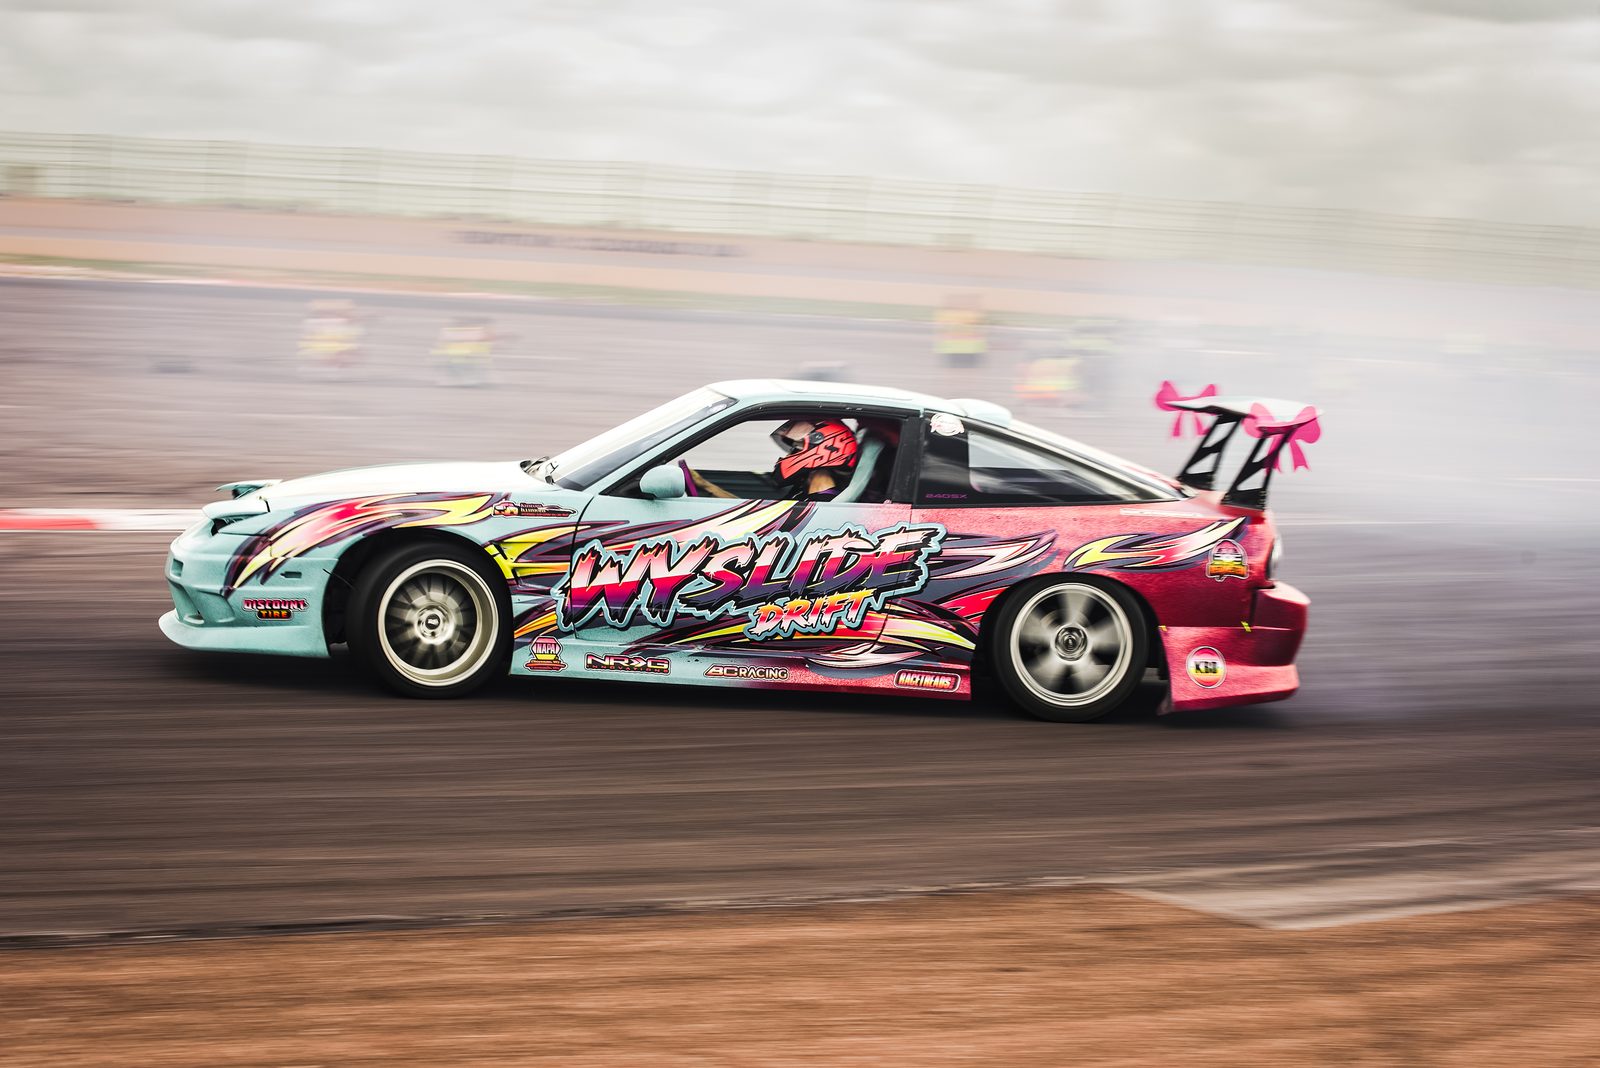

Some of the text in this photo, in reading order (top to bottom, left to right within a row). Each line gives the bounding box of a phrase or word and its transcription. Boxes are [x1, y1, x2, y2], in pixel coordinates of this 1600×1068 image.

[561, 526, 938, 626] WYSLIDE
[243, 599, 306, 610] DISCOUNT
[260, 610, 288, 618] TIRE
[749, 588, 877, 636] DRIFT
[535, 642, 557, 654] NAPA
[898, 672, 953, 689] RACETREADS
